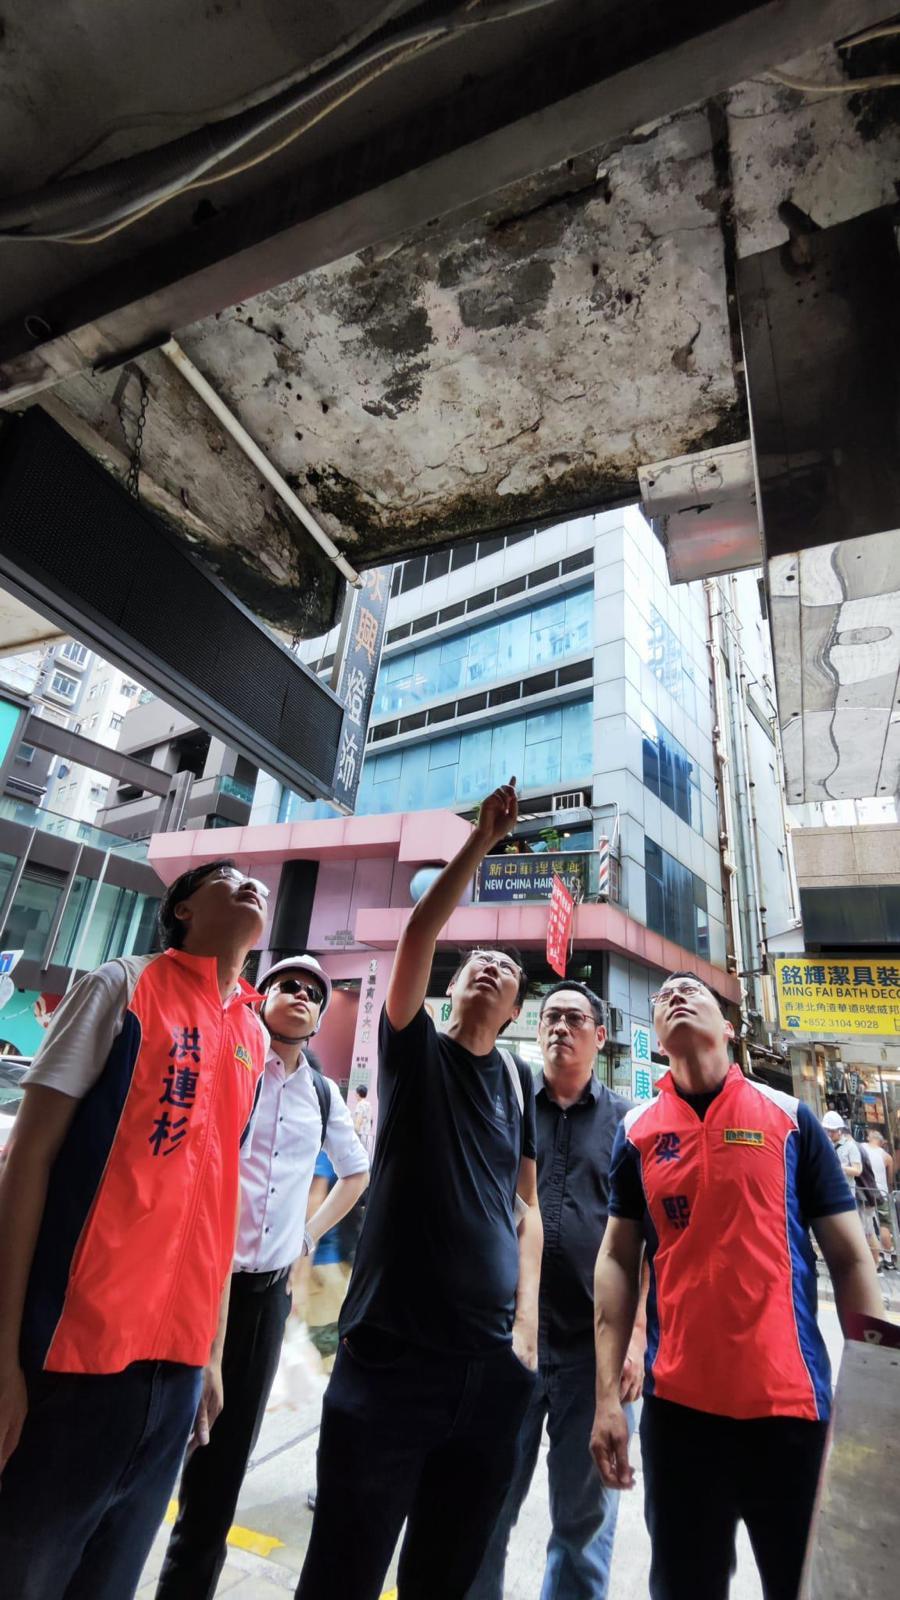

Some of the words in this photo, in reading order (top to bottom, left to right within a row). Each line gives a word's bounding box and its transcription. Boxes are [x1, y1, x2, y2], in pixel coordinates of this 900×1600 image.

[485, 879, 503, 890] NEW
[505, 878, 531, 890] CHINA
[533, 877, 553, 888] HAIR
[781, 965, 900, 986] 銘輝潔具裝
[782, 987, 812, 997] MING
[816, 987, 833, 997] FAI
[836, 988, 868, 998] BATH
[803, 1018, 826, 1027] +852
[830, 1018, 852, 1028] 3104
[855, 1019, 879, 1029] 9028
[633, 1029, 651, 1100] 復康
[148, 1026, 201, 1156] 洪連杉
